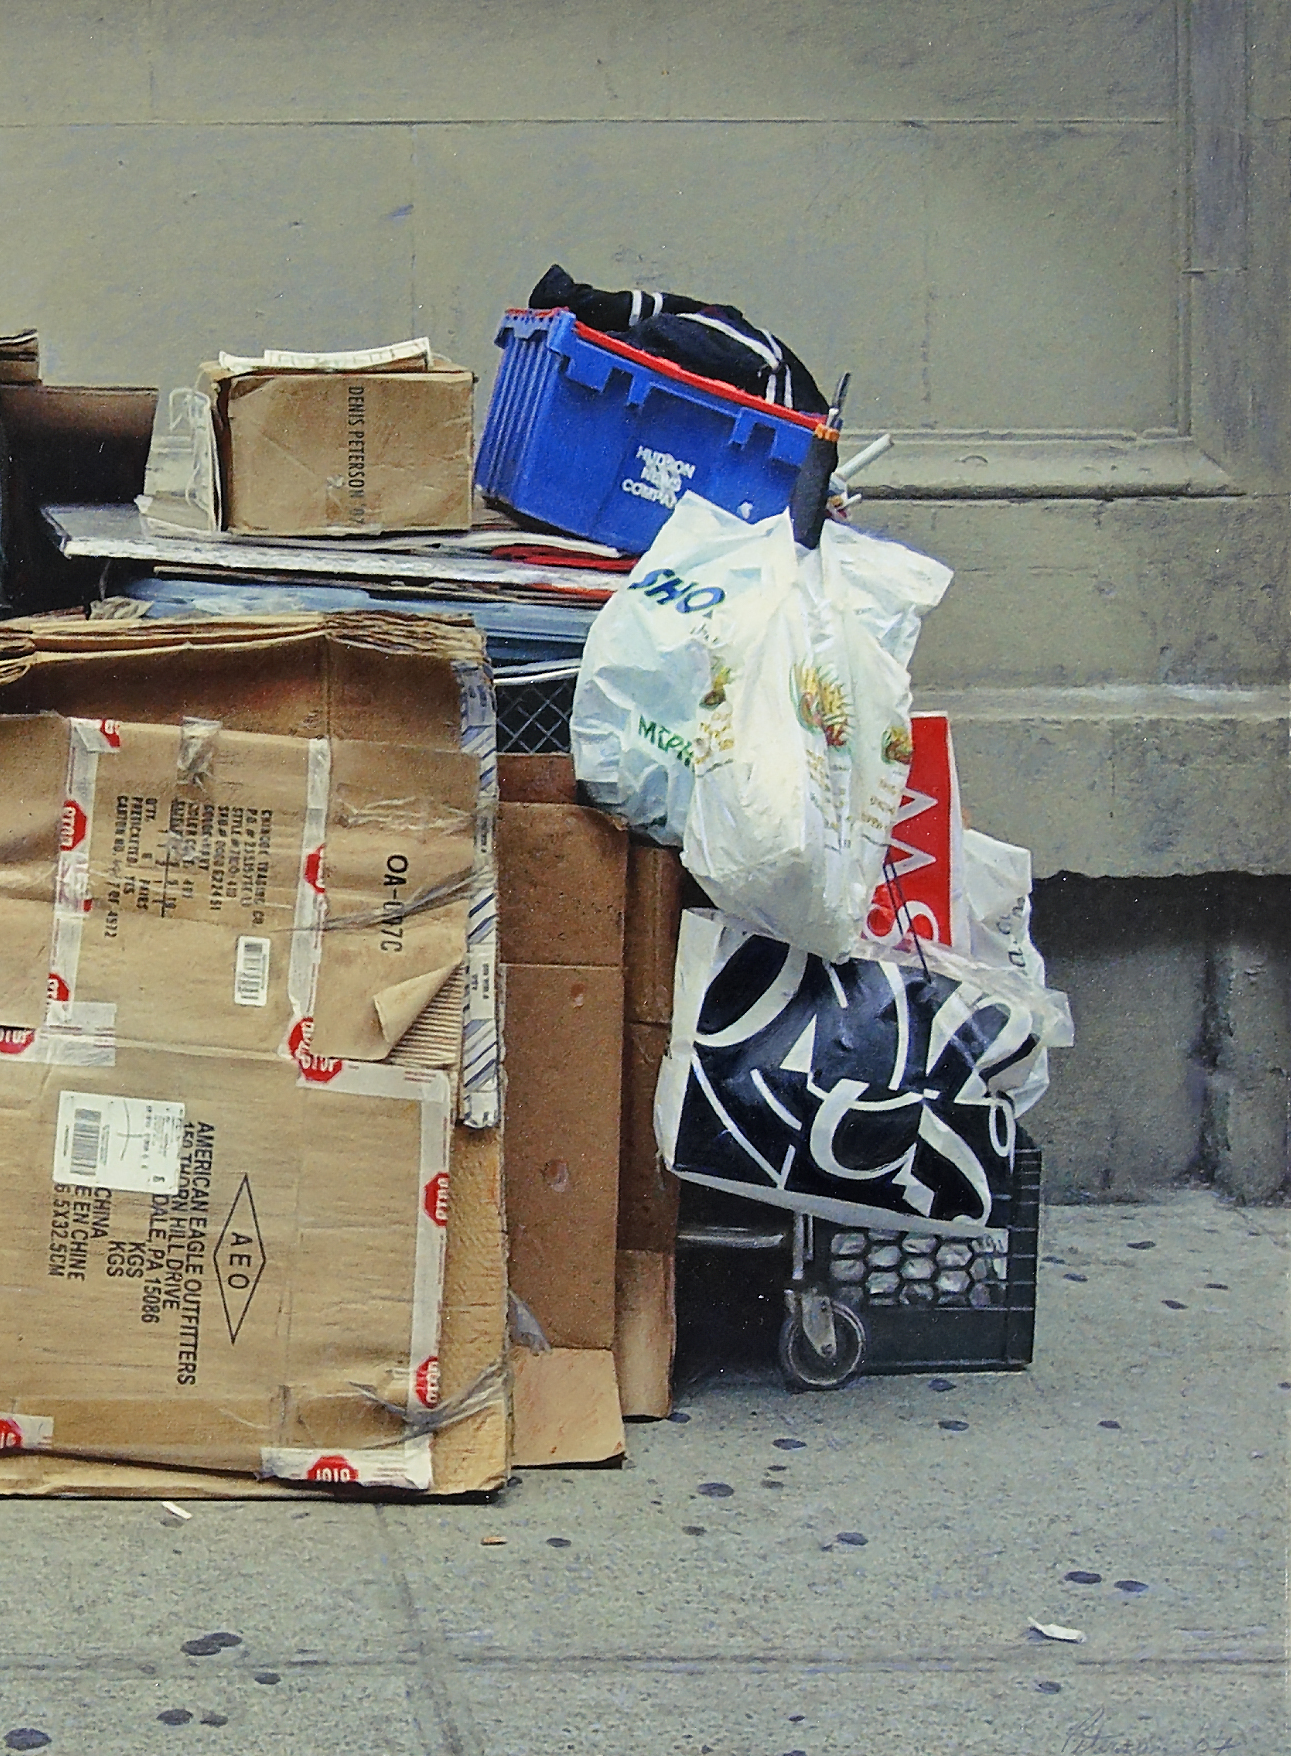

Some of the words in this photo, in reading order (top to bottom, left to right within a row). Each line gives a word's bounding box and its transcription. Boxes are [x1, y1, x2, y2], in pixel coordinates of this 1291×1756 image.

[348, 386, 366, 426] DENIS
[348, 431, 366, 498] PETERSON
[188, 1120, 215, 1211] AMERICAN
[72, 1201, 91, 1228] EN
[90, 1187, 112, 1240] CHINA
[166, 1215, 189, 1255] HILL
[66, 1230, 89, 1282] CHINE
[106, 1239, 128, 1279] KGS
[124, 1240, 147, 1279] KGS
[146, 1248, 167, 1272] PA
[184, 1215, 208, 1276] EAGLE
[141, 1275, 162, 1324] 15086
[161, 1257, 185, 1311] DRIVE
[176, 1278, 203, 1387] OUTFITTERS
